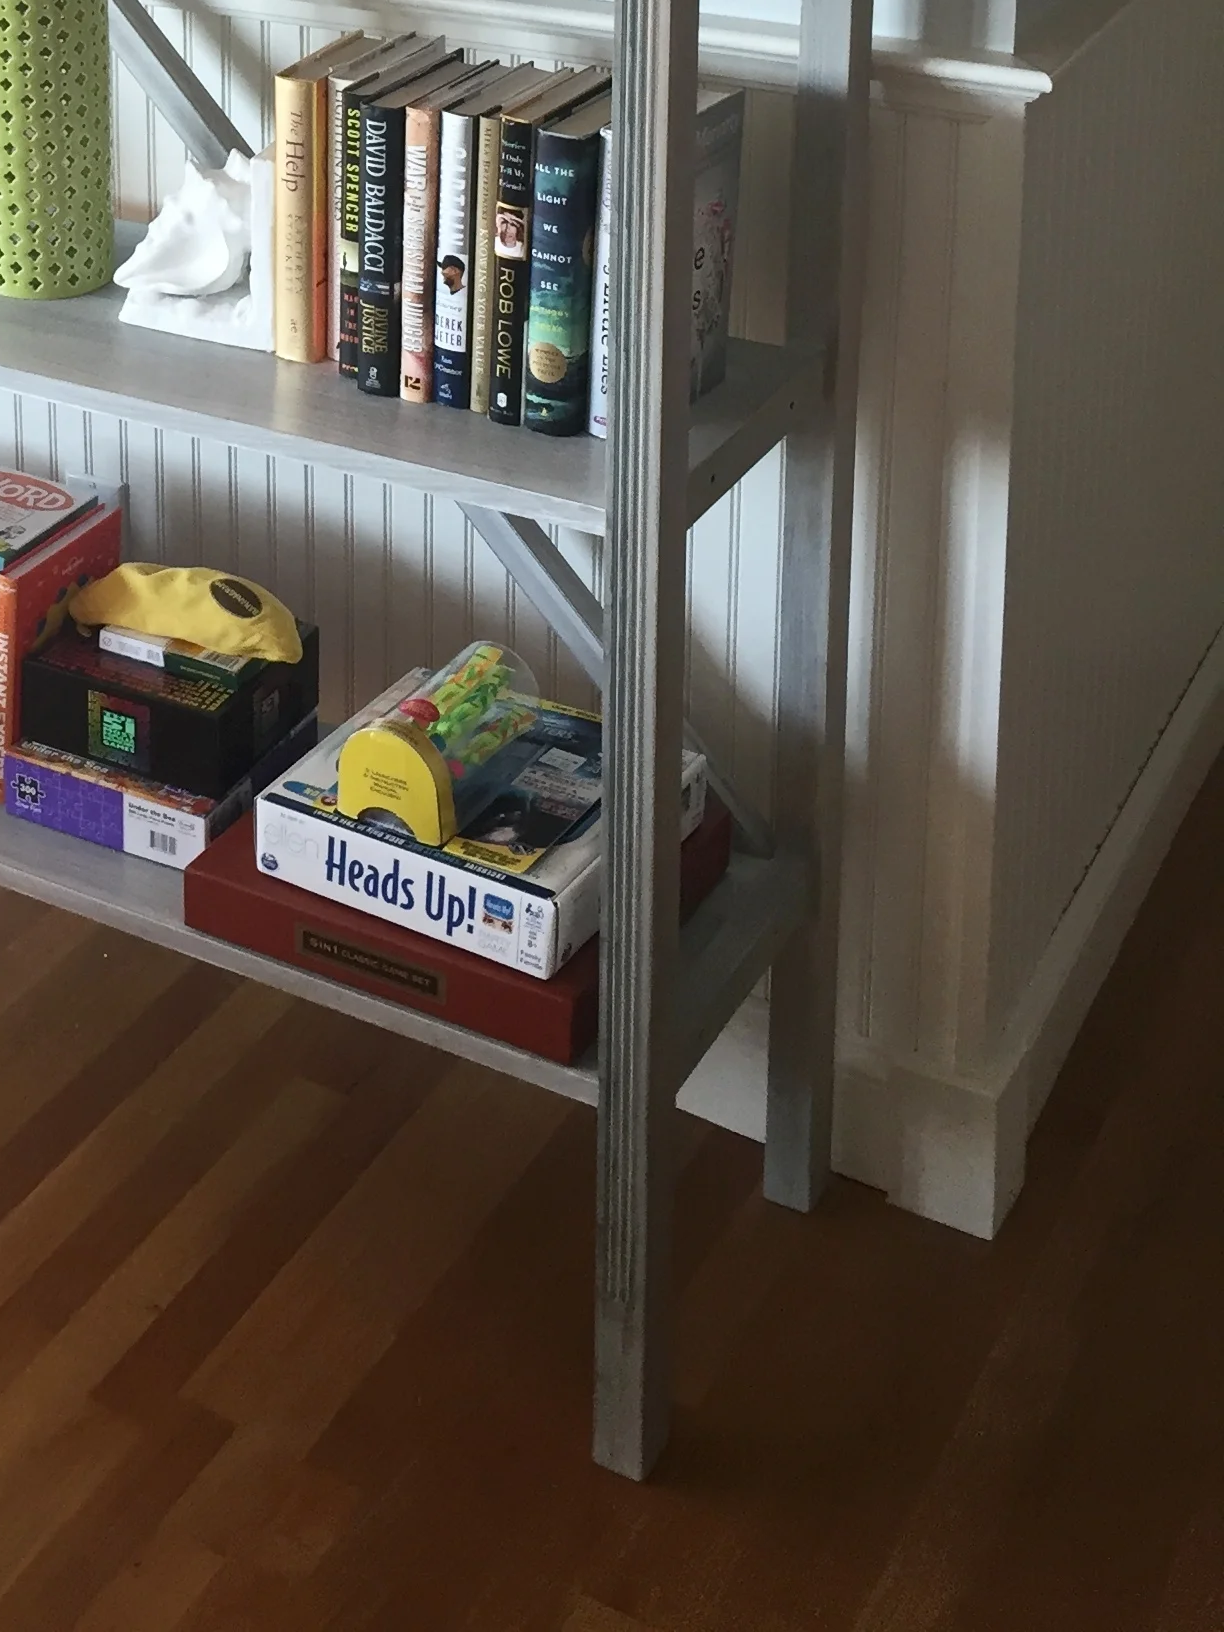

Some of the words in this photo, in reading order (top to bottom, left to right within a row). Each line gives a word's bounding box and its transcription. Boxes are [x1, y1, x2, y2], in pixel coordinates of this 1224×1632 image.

[289, 110, 304, 136] The
[345, 107, 361, 158] SCOTT
[280, 138, 306, 193] Help
[364, 118, 387, 178] DAVID
[406, 144, 428, 192] WAR
[534, 162, 551, 175] ALL
[554, 167, 575, 178] THE
[345, 162, 359, 233] SPENCER
[536, 192, 568, 206] LIGHT
[364, 181, 387, 274] BALDACCI
[542, 222, 559, 235] WE
[404, 216, 425, 295] SEBASTIAN
[476, 227, 490, 292] KNOWING
[531, 248, 573, 264] CANNOT
[498, 266, 515, 315] ROB
[540, 280, 559, 291] SEE
[360, 299, 376, 354] JUSTICE
[375, 307, 388, 354] DIVINE
[403, 297, 424, 354] JUNGER
[434, 329, 462, 347] JETER
[435, 313, 463, 332] DEREK
[475, 297, 488, 332] YOUR
[475, 334, 487, 376] VALUE
[495, 318, 513, 381] LOWE
[21, 740, 60, 758] Under
[60, 753, 82, 765] the
[83, 759, 109, 774] Sea
[262, 820, 321, 861] ellen
[324, 834, 416, 910] Heads
[424, 870, 476, 937] Up!
